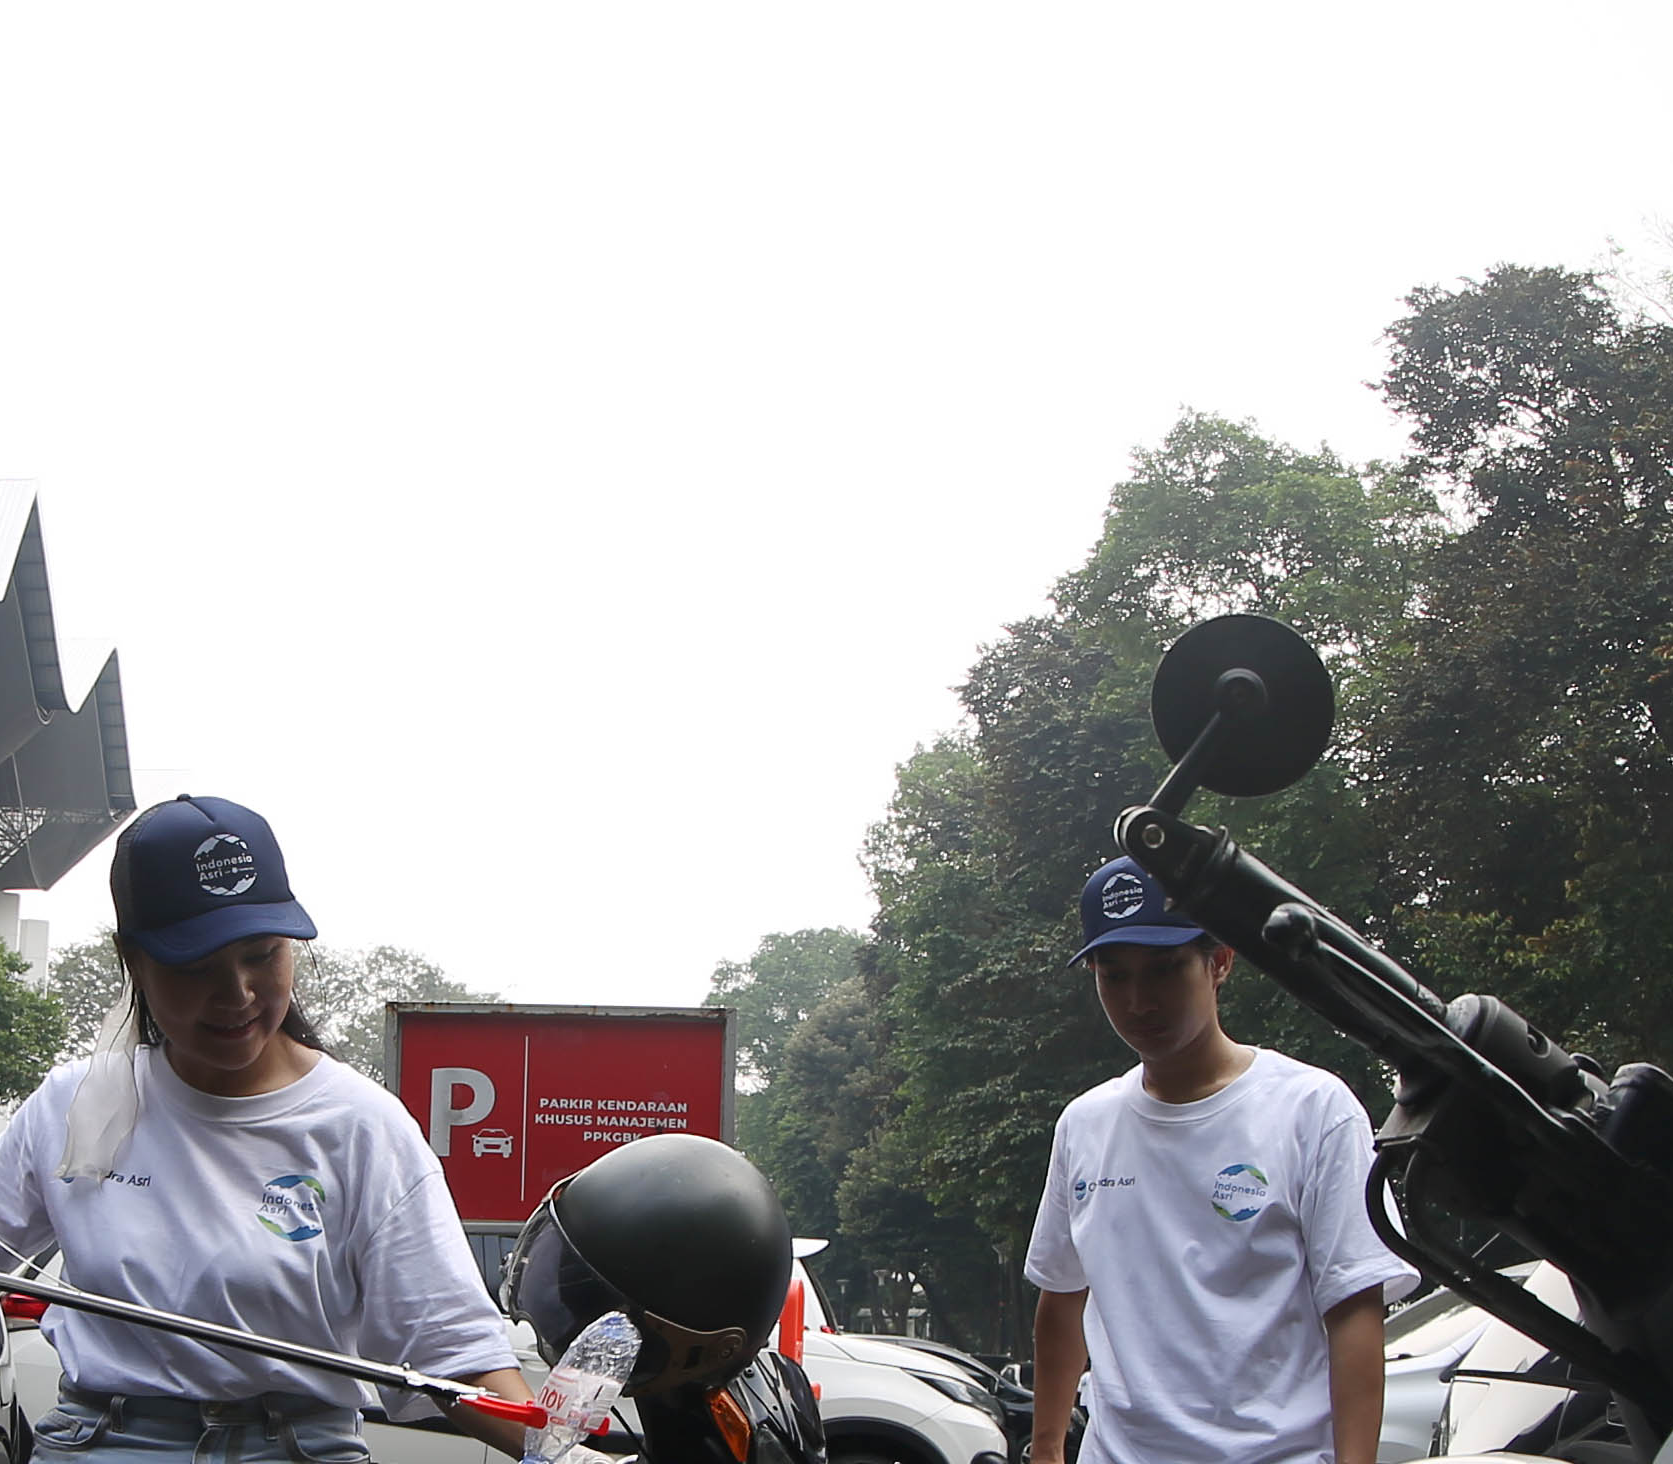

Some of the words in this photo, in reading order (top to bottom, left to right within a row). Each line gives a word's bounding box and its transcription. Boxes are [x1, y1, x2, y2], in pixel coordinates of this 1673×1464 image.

[196, 853, 253, 872] Indonesia
[199, 868, 223, 882] Asri
[430, 1067, 496, 1157] P
[539, 1098, 593, 1110] PARKIR
[597, 1100, 688, 1113] KENDARAAN
[534, 1114, 593, 1126] KHUSUS
[596, 1116, 687, 1129] MANAJEMEN
[127, 1175, 151, 1187] Asri
[1117, 1176, 1135, 1187] Asri
[1214, 1180, 1266, 1197] Indonesia
[262, 1193, 315, 1211] Indones
[1212, 1190, 1233, 1200] Asri
[259, 1204, 287, 1215] Asri
